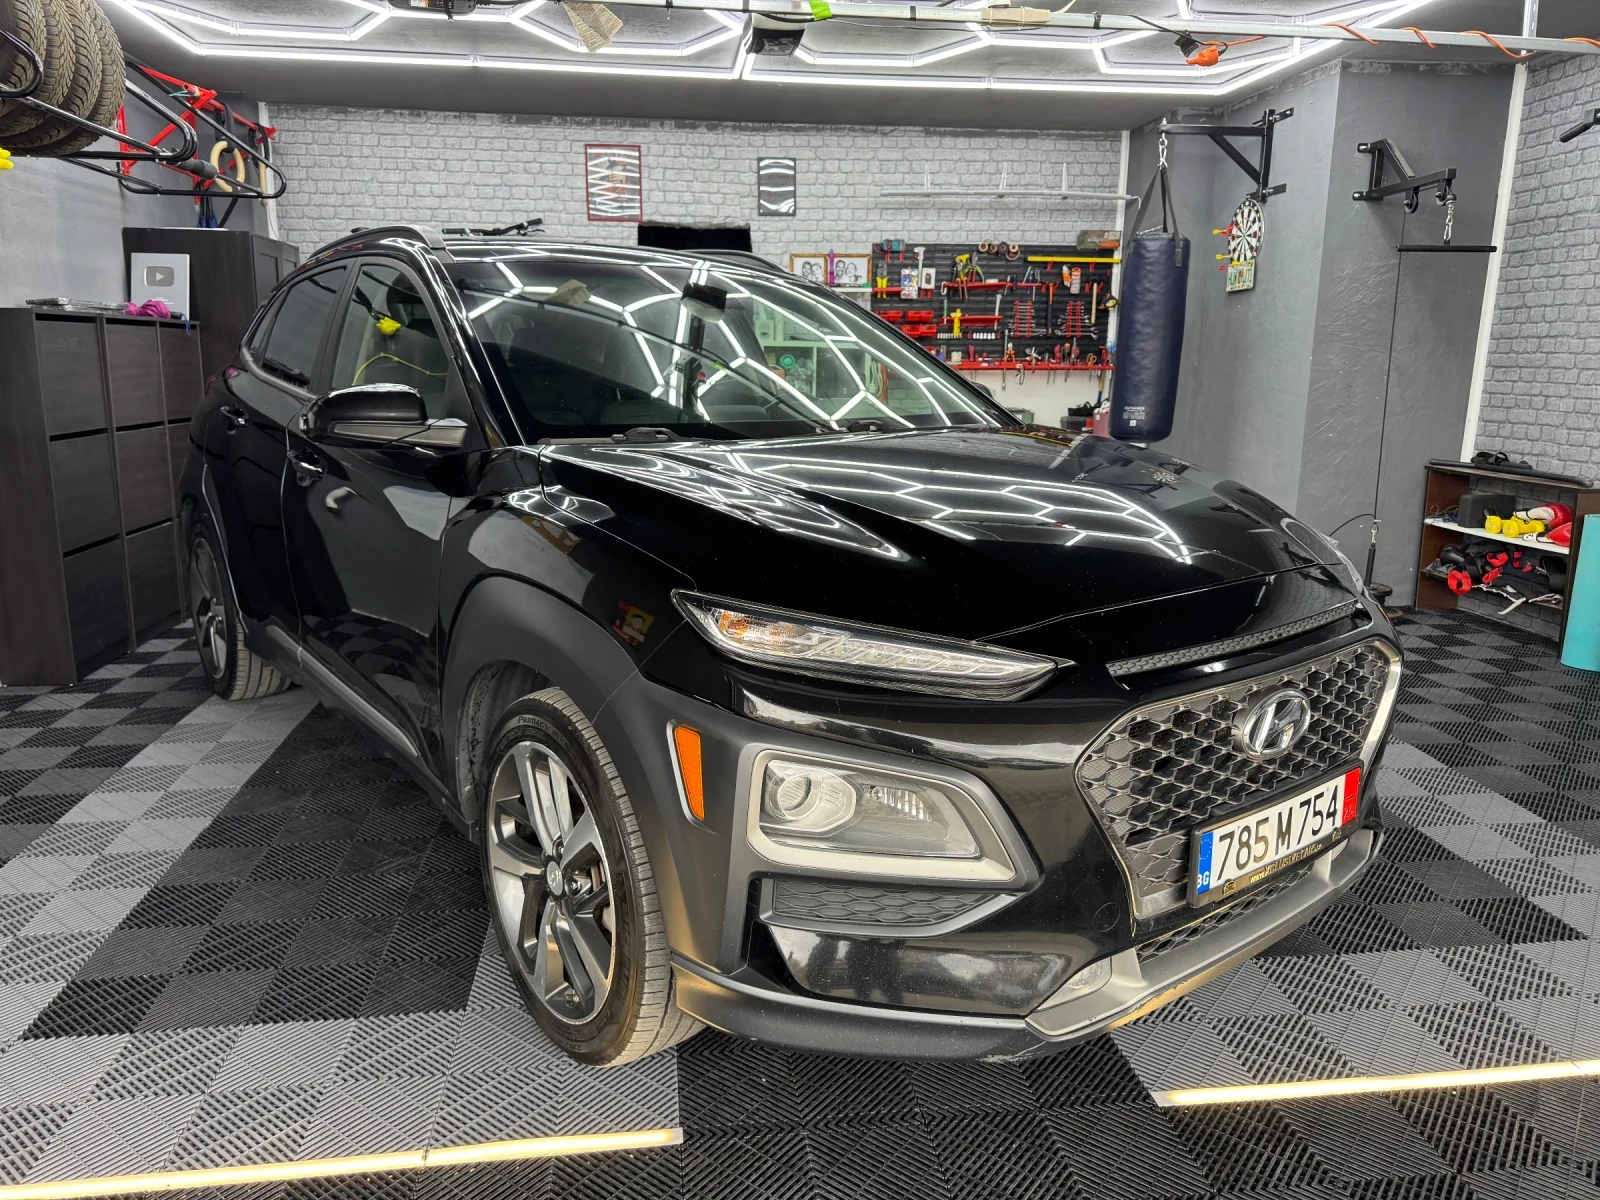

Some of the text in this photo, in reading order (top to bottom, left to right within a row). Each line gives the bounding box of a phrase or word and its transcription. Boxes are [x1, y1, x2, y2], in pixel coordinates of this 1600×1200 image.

[517, 715, 551, 731] PRIMACY
[1216, 784, 1338, 881] 785 M 754
